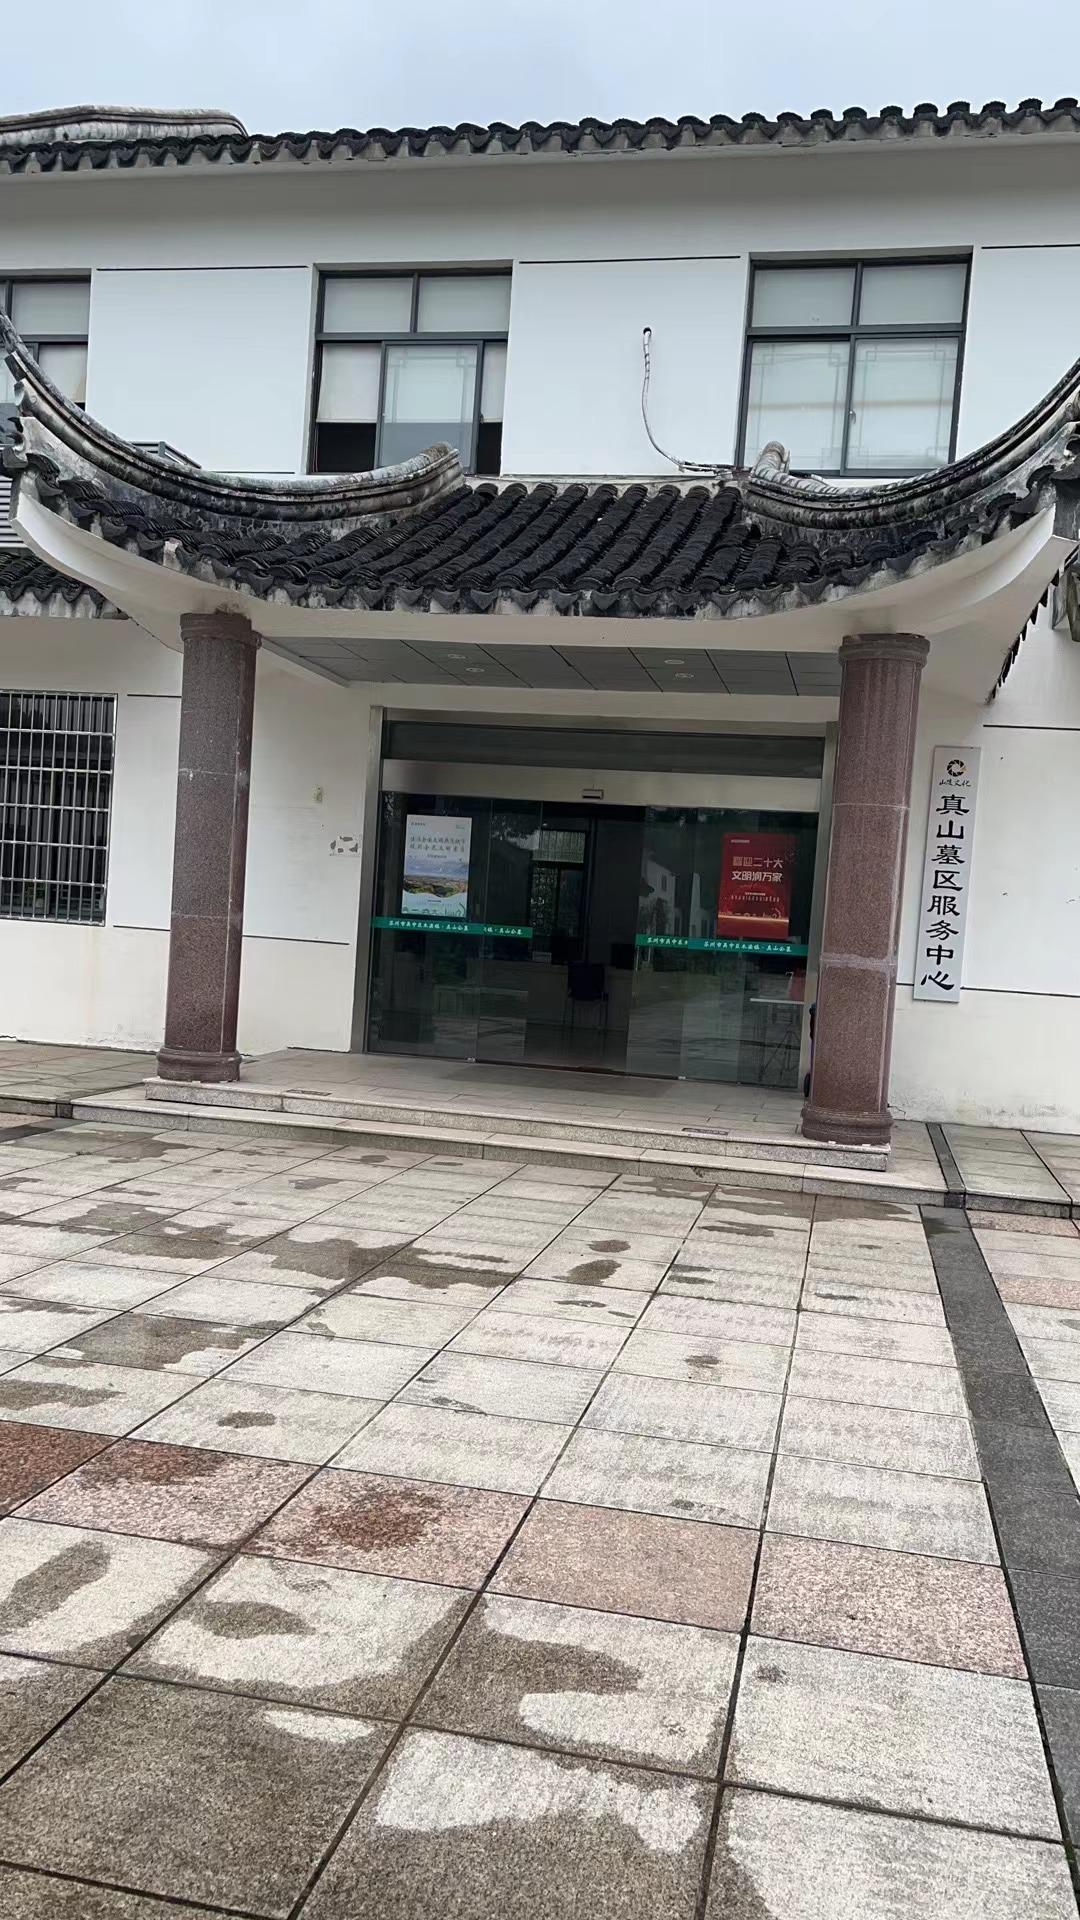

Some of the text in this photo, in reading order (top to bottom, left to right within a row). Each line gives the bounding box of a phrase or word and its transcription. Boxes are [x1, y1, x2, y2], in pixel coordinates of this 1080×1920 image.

[732, 856, 783, 869] 喜迎二十大
[731, 870, 783, 883] 文明润万家
[920, 794, 970, 990] 真山墓区服务中心
